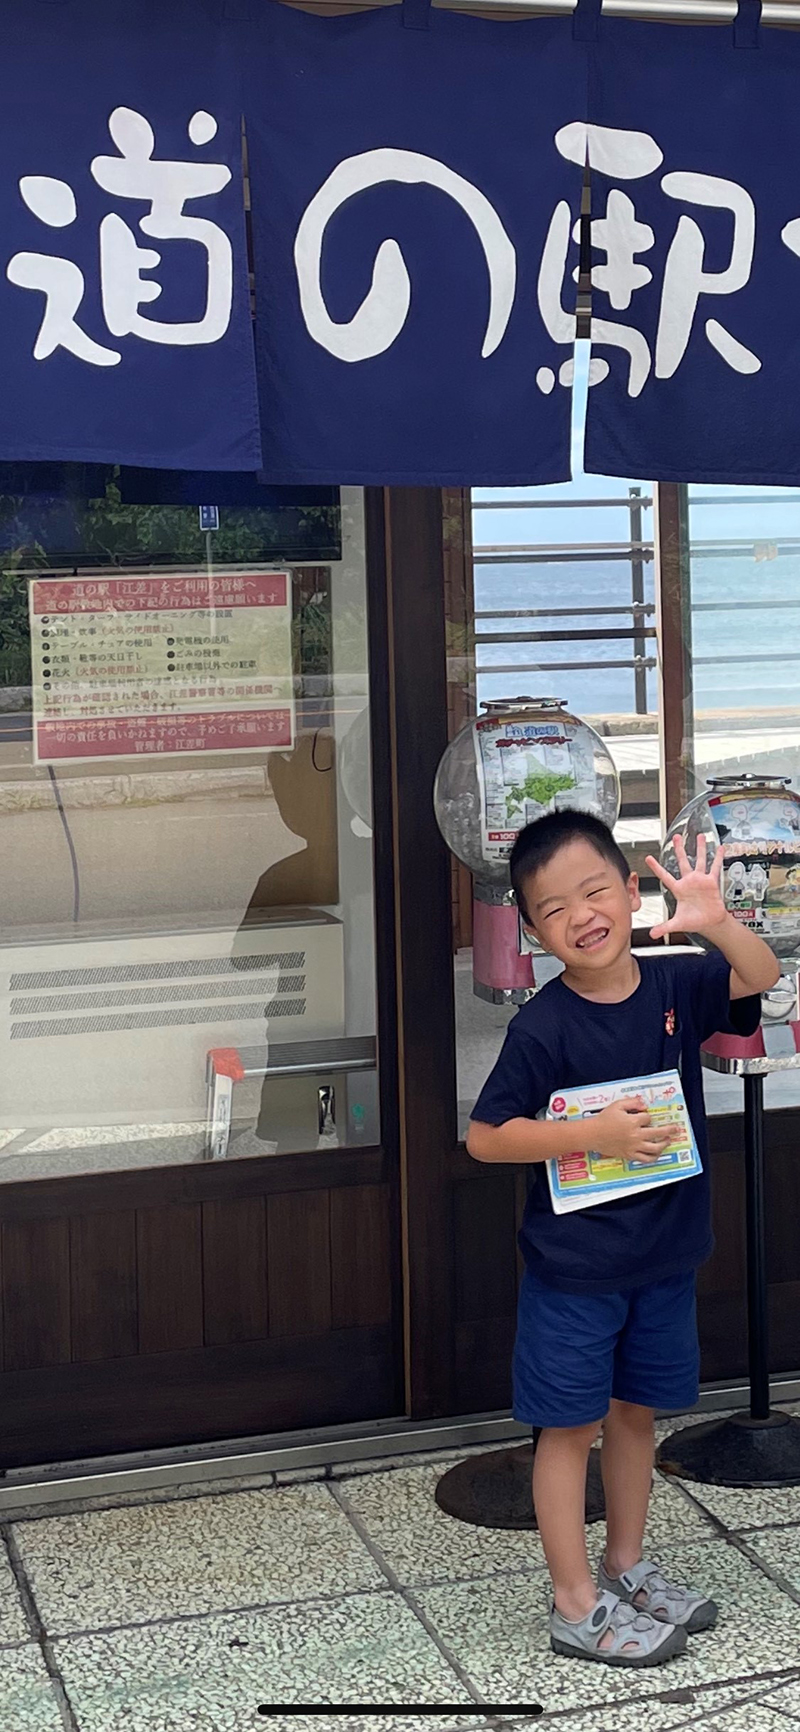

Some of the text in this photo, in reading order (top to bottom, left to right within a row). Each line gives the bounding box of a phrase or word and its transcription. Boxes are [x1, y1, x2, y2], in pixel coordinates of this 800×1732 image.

[7, 106, 800, 397] 道の駅
[71, 578, 257, 597] 道の駅「江差」をご利用の皆様へ
